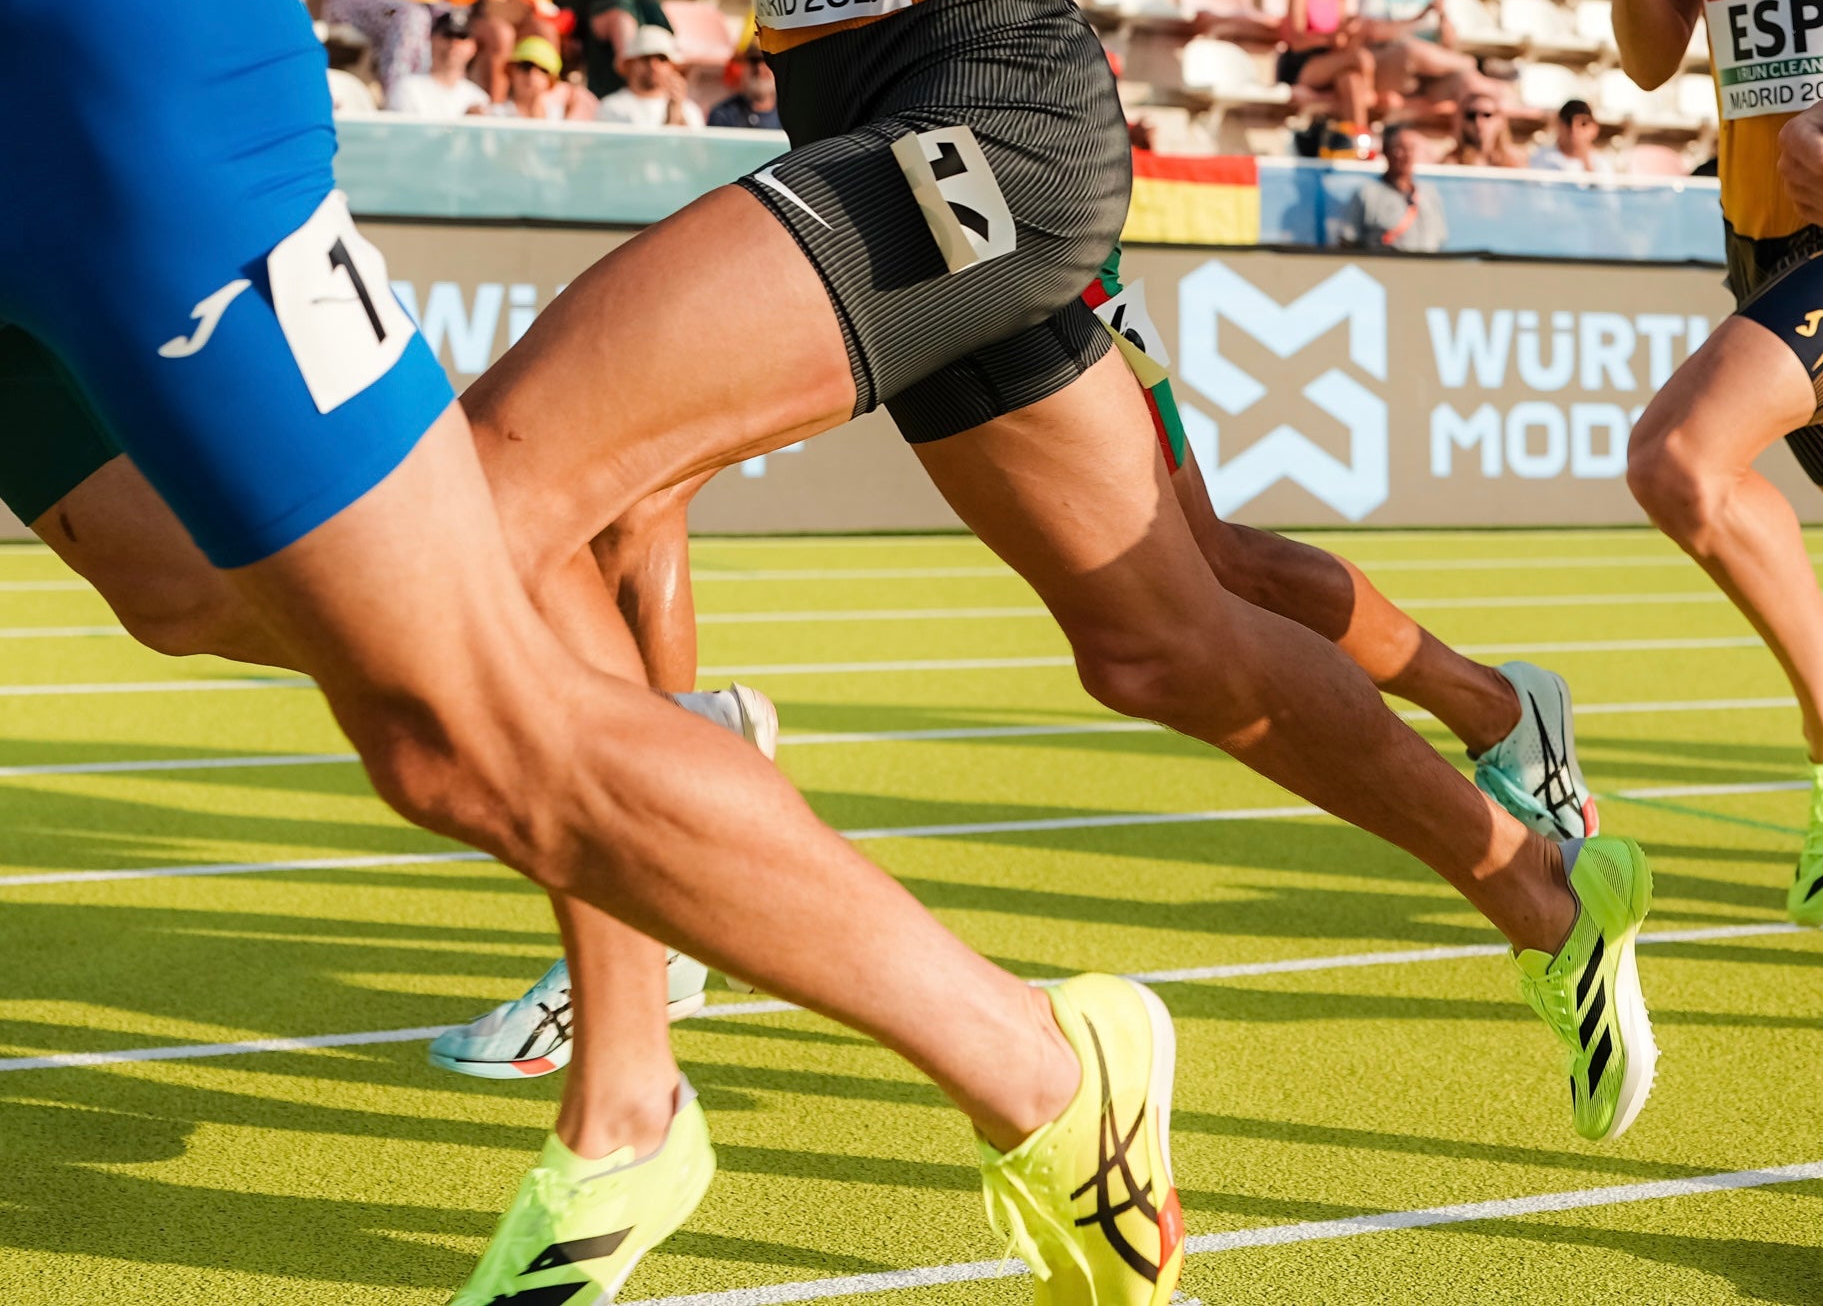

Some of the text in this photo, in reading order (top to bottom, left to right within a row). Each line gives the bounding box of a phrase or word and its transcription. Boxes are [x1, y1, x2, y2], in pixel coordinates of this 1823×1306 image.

[1769, 58, 1823, 77] CLEAN
[1730, 85, 1794, 110] MADRID
[328, 236, 386, 344] 1
[1429, 400, 1645, 479] MOD
